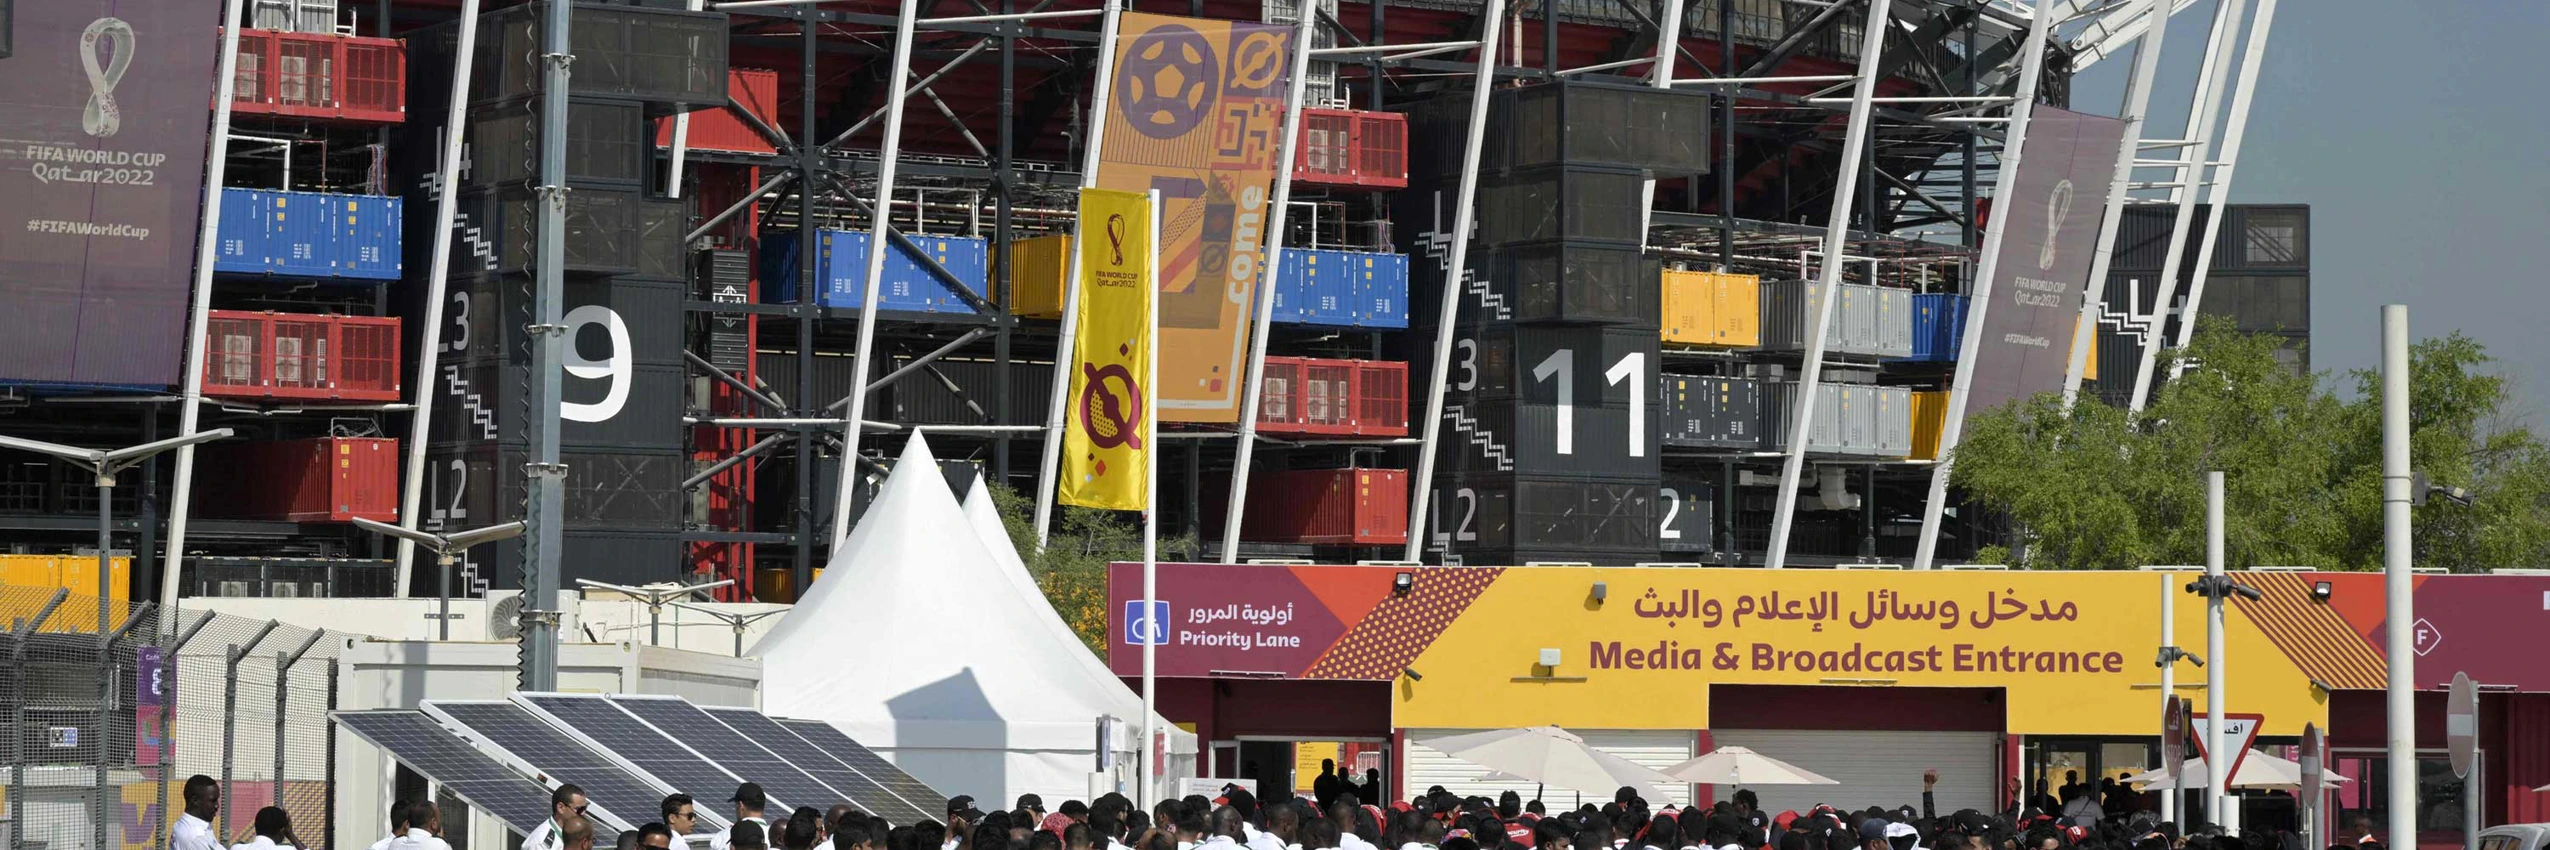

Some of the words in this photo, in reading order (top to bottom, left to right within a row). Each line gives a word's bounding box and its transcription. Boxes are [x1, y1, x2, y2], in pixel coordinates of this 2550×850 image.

[26, 145, 64, 161] FIFA
[67, 149, 129, 165] WORLD
[132, 153, 166, 167] CUP
[27, 219, 150, 240] #FIFAWorldCup
[1106, 271, 1127, 279] WORLD
[2014, 276, 2030, 288] FIFA
[2030, 279, 2054, 292] WORLD
[2053, 282, 2066, 294] CUP
[2004, 333, 2050, 349] #FIFAWorldCup
[560, 305, 632, 422] 9
[1533, 349, 1645, 457] 11
[431, 459, 466, 518] L2
[1432, 488, 1477, 541] L2
[1188, 604, 1237, 624] المرور
[1241, 602, 1293, 625] أولوية
[1634, 587, 1723, 628] والبث
[1732, 590, 1838, 632] الإعلام
[1849, 588, 1960, 630] وسائل
[1969, 587, 2078, 629] مدخل
[1180, 630, 1251, 650] Priority
[1256, 632, 1300, 647] Lane
[2417, 629, 2428, 645] F
[1590, 640, 1701, 670] Media
[1712, 642, 1740, 671] &
[1751, 642, 1943, 672] Broadcast
[1953, 643, 2123, 673] Entrance
[2167, 744, 2182, 763] STOP
